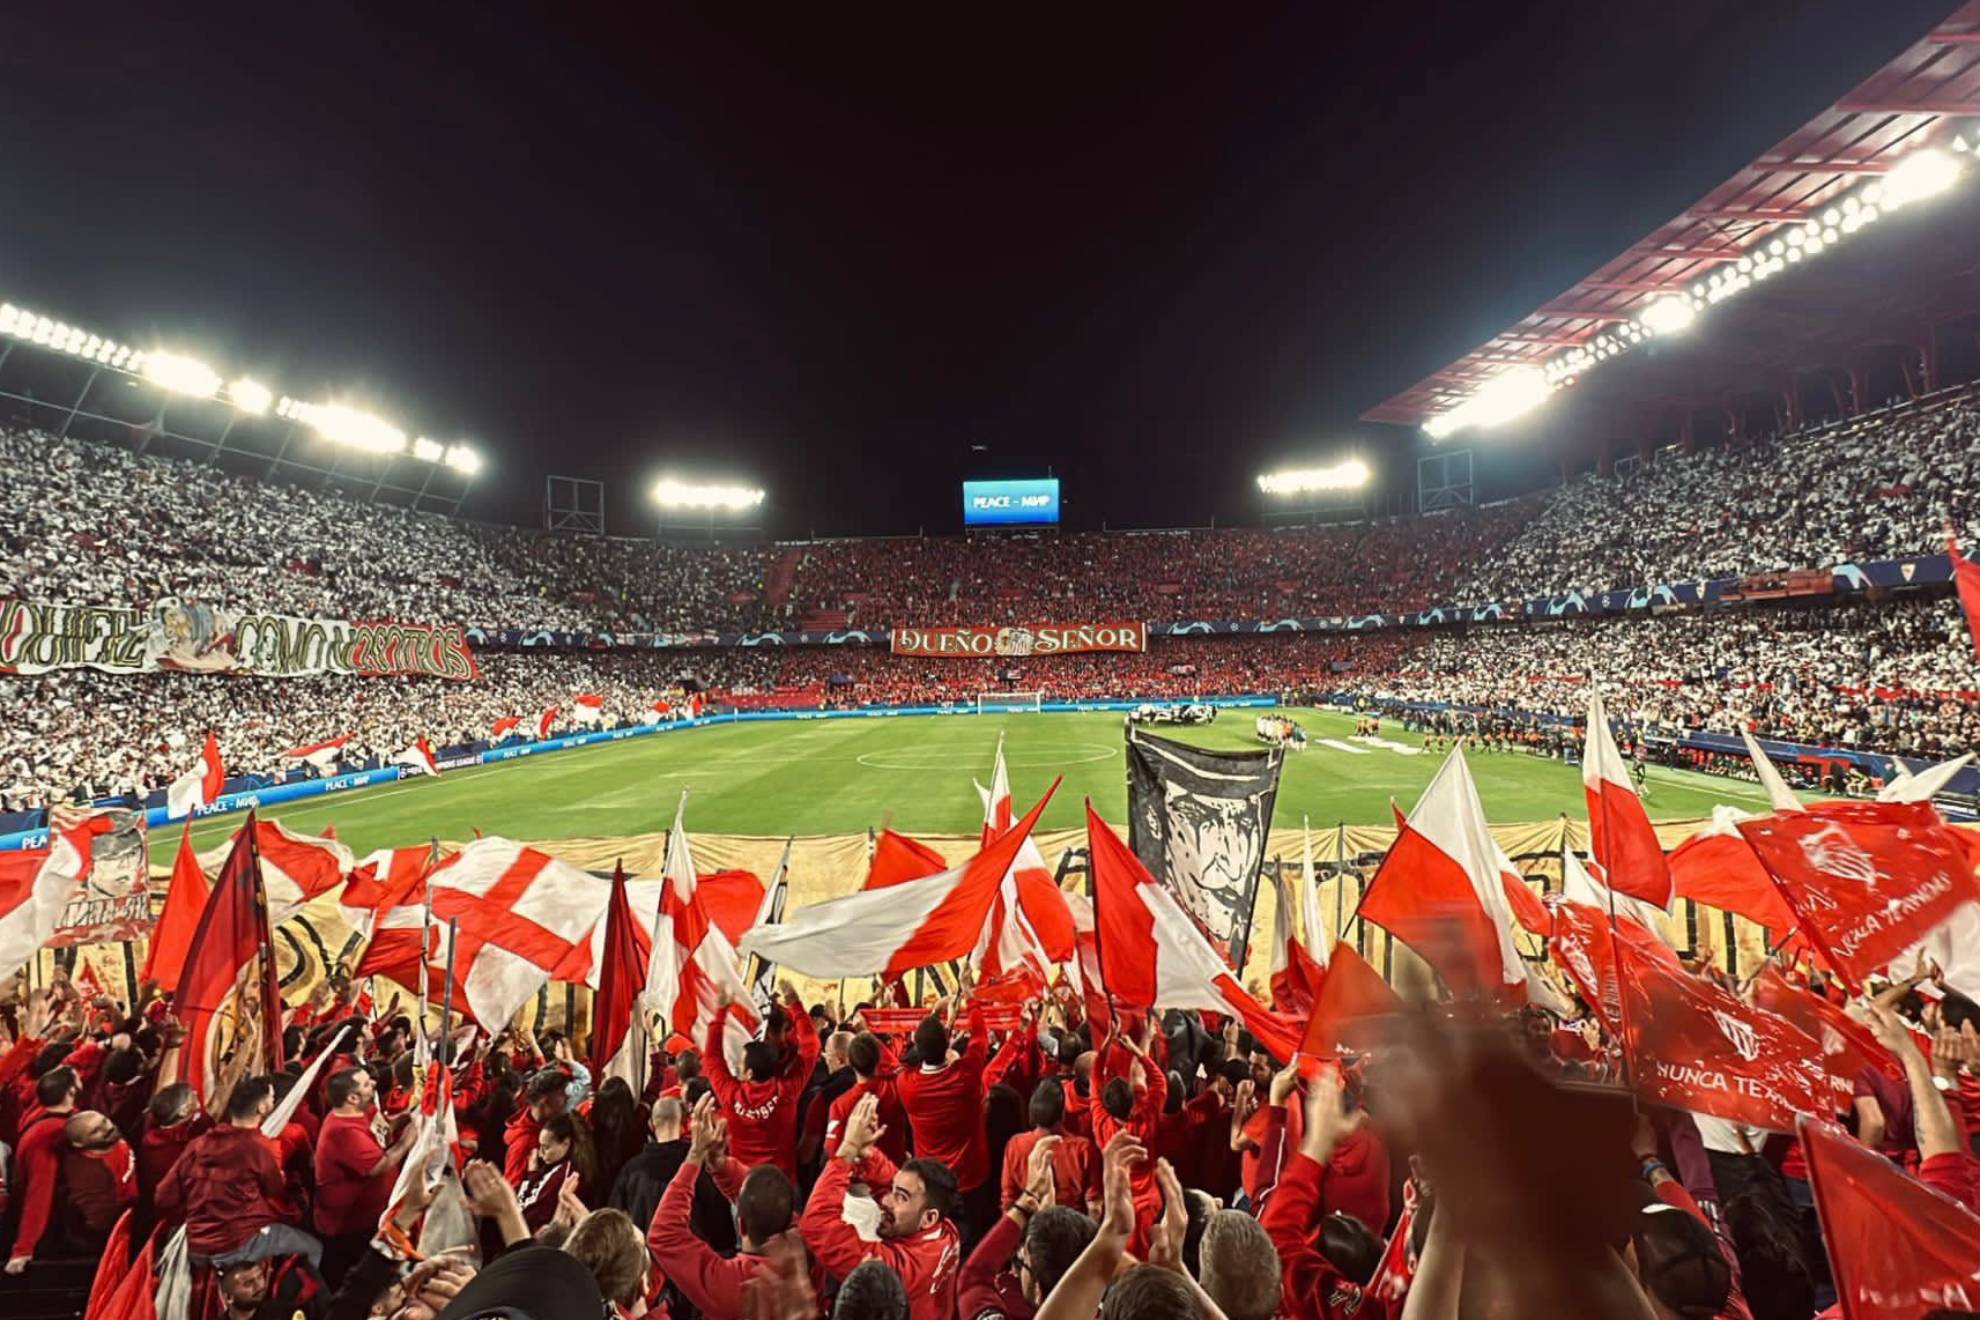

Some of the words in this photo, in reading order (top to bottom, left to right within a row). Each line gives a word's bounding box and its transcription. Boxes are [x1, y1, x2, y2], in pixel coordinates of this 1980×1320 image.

[973, 496, 1010, 509] PEACE
[900, 629, 993, 653] DUEÑO
[1035, 625, 1138, 651] SEÑOR
[22, 833, 48, 850] PEA
[1656, 1061, 1728, 1092] NUNCA
